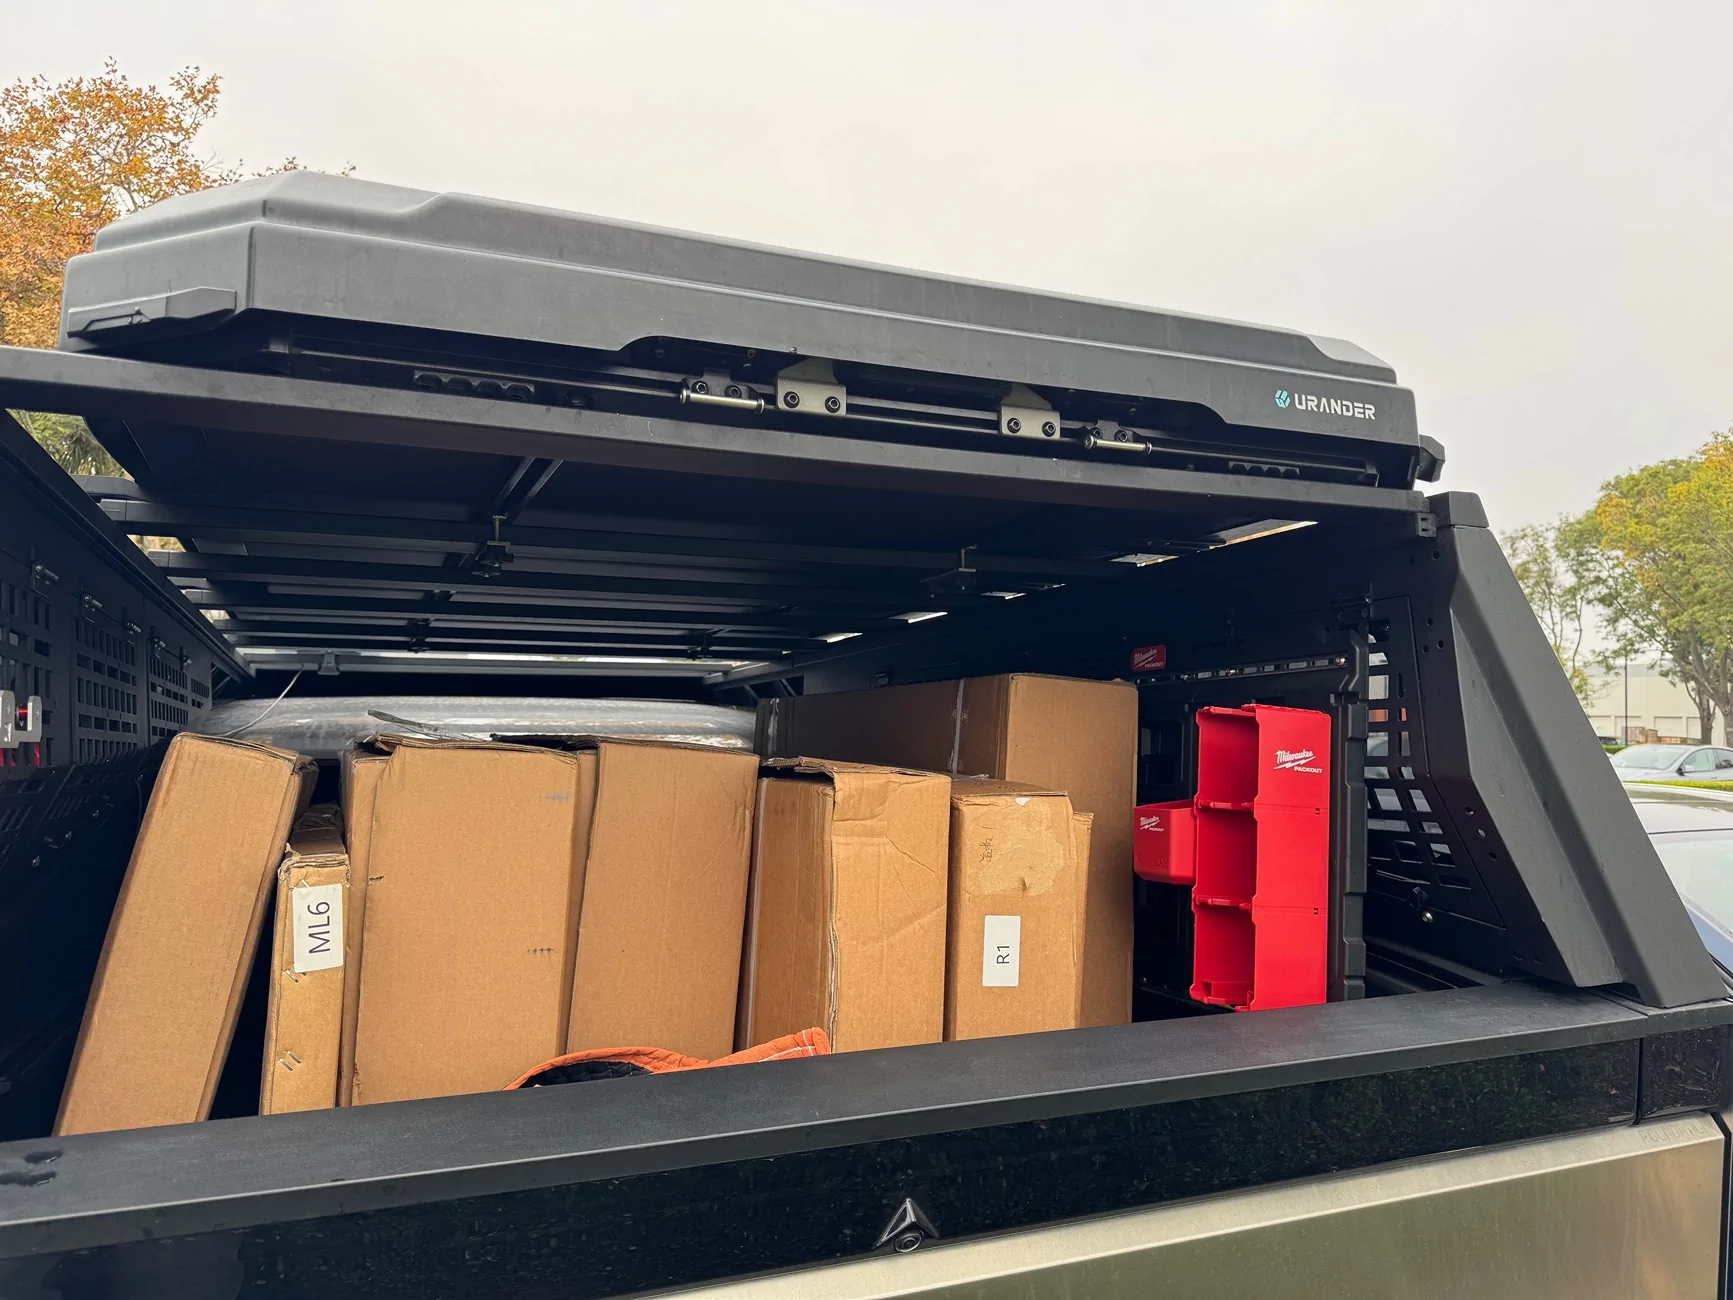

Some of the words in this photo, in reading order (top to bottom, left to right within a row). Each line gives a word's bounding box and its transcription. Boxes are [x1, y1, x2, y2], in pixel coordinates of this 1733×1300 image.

[1294, 393, 1376, 420] URANDER
[1274, 749, 1314, 765] Milwaukee
[1293, 766, 1323, 774] PACKOUT
[307, 901, 331, 954] ML6
[996, 945, 1010, 965] R1
